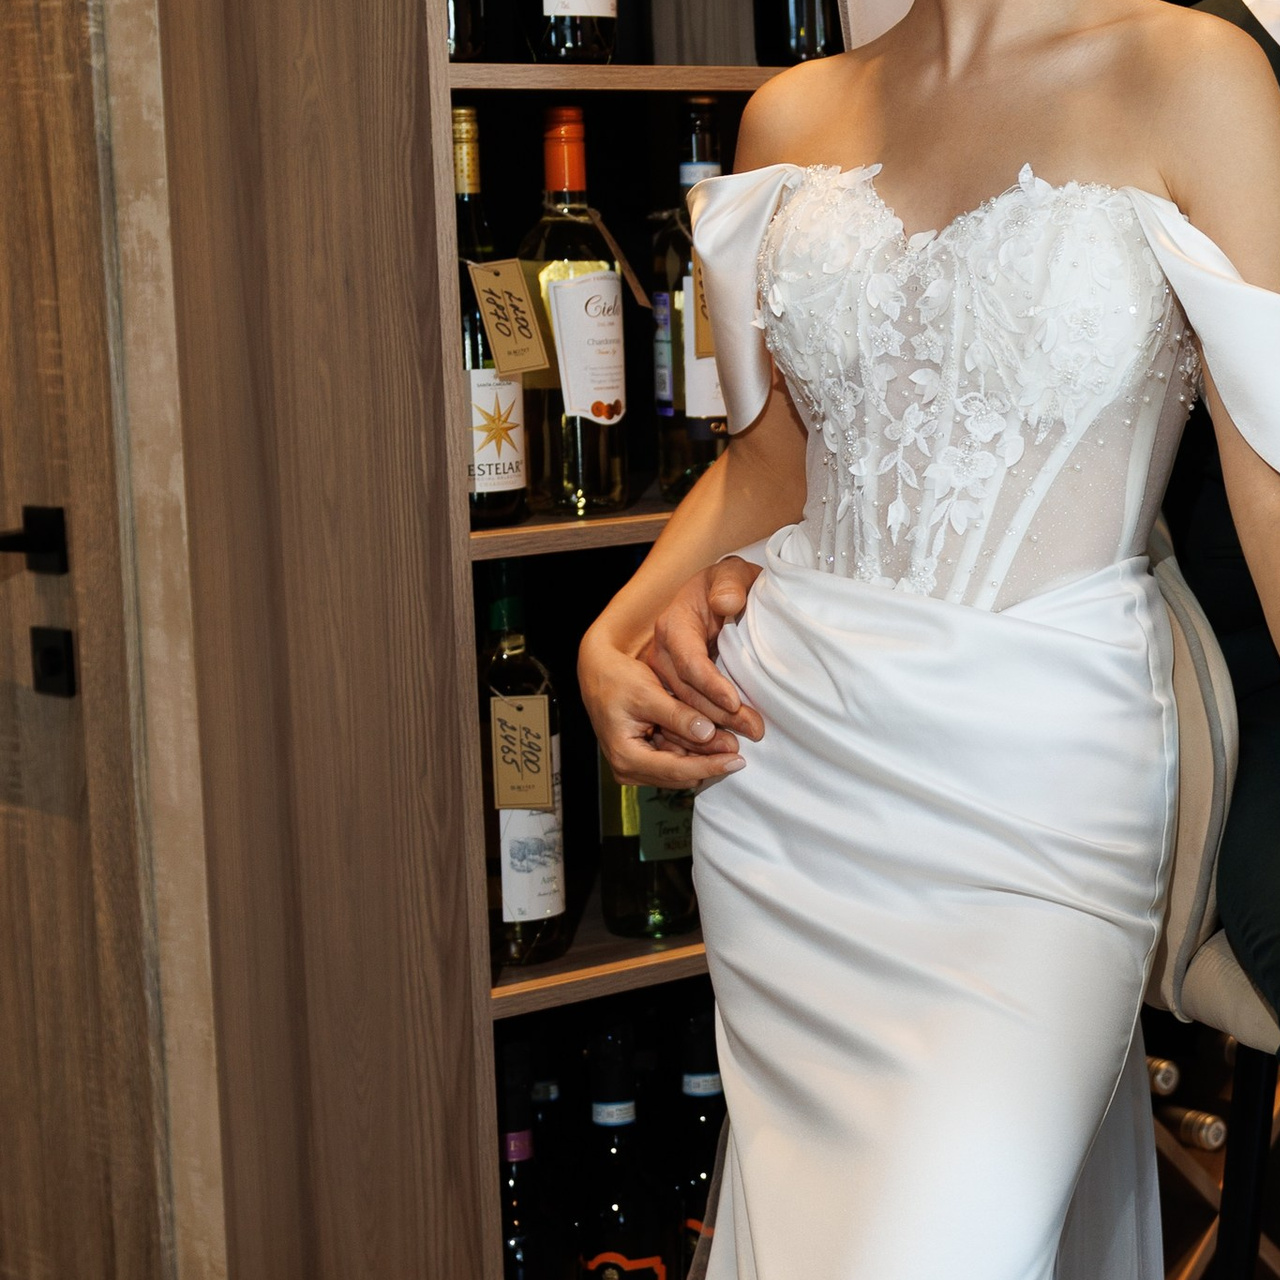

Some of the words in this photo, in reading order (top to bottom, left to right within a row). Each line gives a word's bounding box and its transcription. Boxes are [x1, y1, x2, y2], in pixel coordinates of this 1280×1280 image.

[482, 287, 512, 338] 1870
[504, 289, 533, 340] 2200
[467, 461, 521, 478] ESTELAR
[496, 717, 521, 773] 2465
[522, 725, 542, 775] 2900
